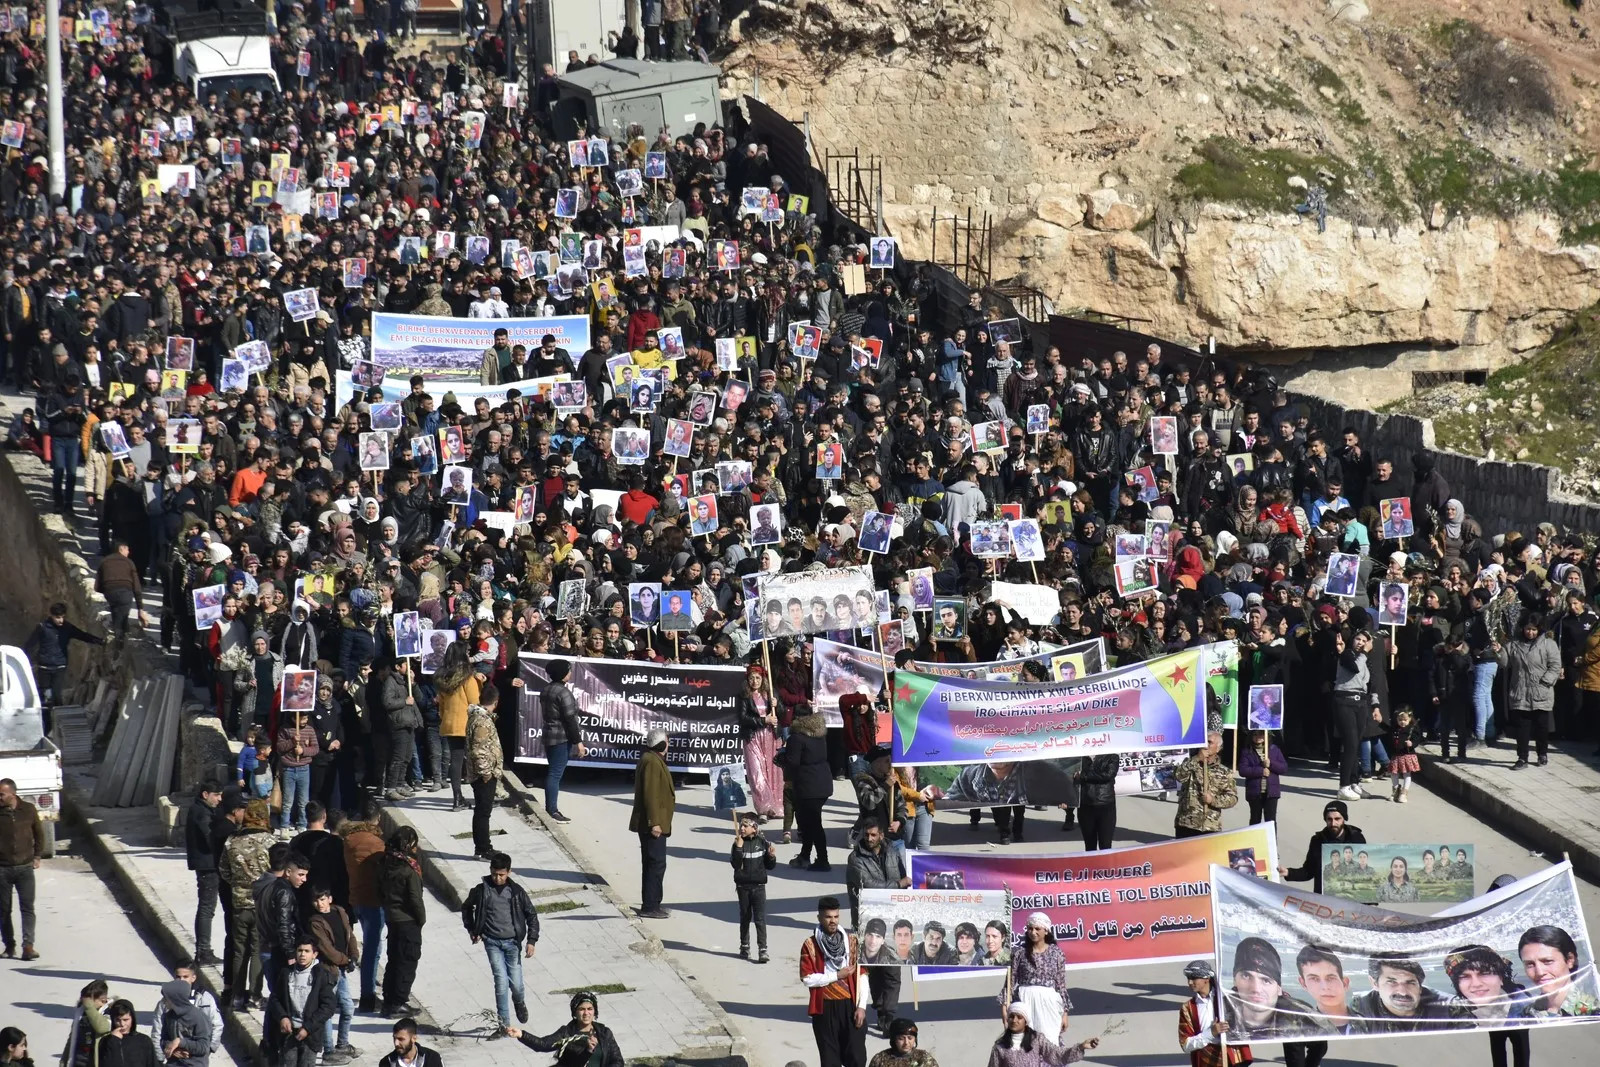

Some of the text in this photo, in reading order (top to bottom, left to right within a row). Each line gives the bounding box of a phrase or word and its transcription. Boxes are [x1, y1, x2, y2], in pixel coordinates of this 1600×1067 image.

[621, 672, 648, 685] عفرين
[650, 675, 680, 686] سنحرر
[1048, 686, 1074, 698] XWE
[705, 695, 735, 710] الدولة
[1041, 705, 1053, 714] TE
[1009, 722, 1042, 736] الرأس
[1045, 718, 1090, 733] مرفوعة
[586, 732, 599, 742] YA
[668, 737, 710, 749] ETEYÊN
[1041, 735, 1078, 750] العالم
[1083, 733, 1111, 748] اليوم
[699, 753, 712, 763] YA
[715, 754, 732, 764] ME
[1035, 871, 1060, 883] EM
[1063, 869, 1073, 882] Ê
[1092, 863, 1152, 880] KUJERÊ
[890, 892, 946, 903] FEDAYIYÊN
[1012, 893, 1053, 910] OKÊN
[1057, 889, 1111, 907] EFRÎNÊ
[1116, 888, 1147, 903] TOL
[1088, 919, 1118, 941] قاتل
[1123, 921, 1143, 939] من
[1151, 915, 1206, 939] سننتقم
